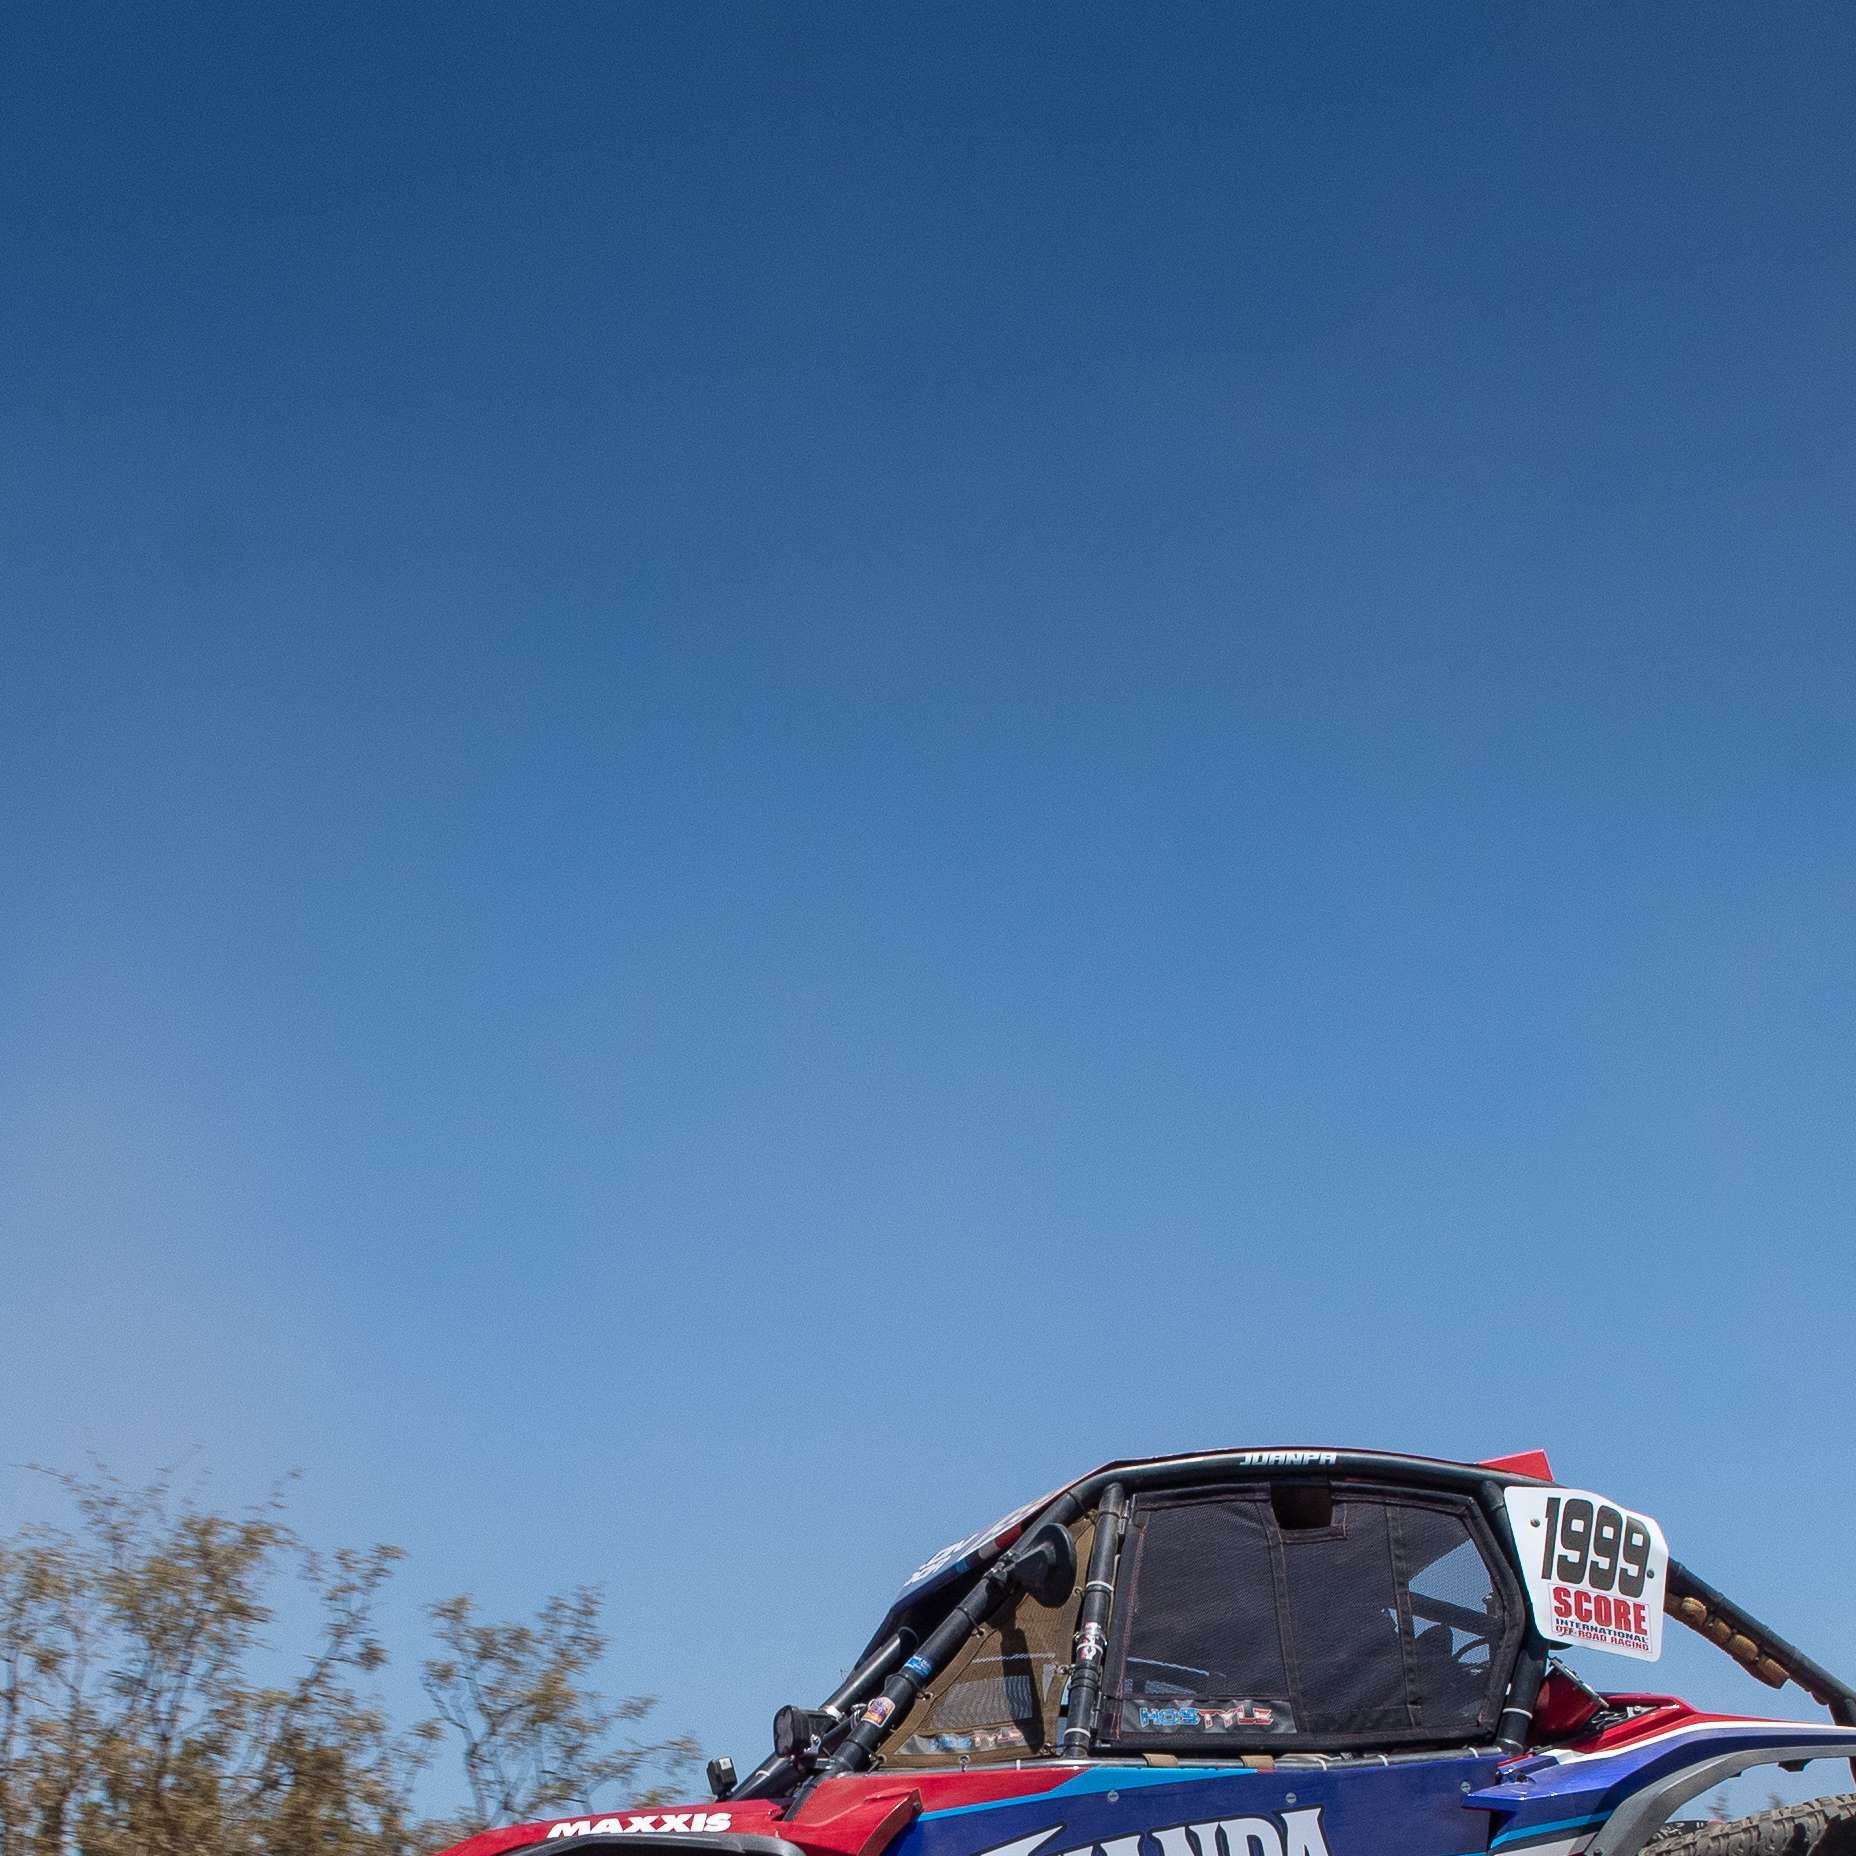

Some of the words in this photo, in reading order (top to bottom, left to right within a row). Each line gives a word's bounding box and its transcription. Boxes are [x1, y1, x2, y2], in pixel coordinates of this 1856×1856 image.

[1239, 1451, 1337, 1466] JUANPA
[1541, 1497, 1651, 1598] 1999
[1553, 1586, 1648, 1635] SCORE
[1555, 1618, 1648, 1643] INTERNATIONAL
[1610, 1636, 1649, 1650] RACING
[546, 1812, 732, 1839] MAXXIS
